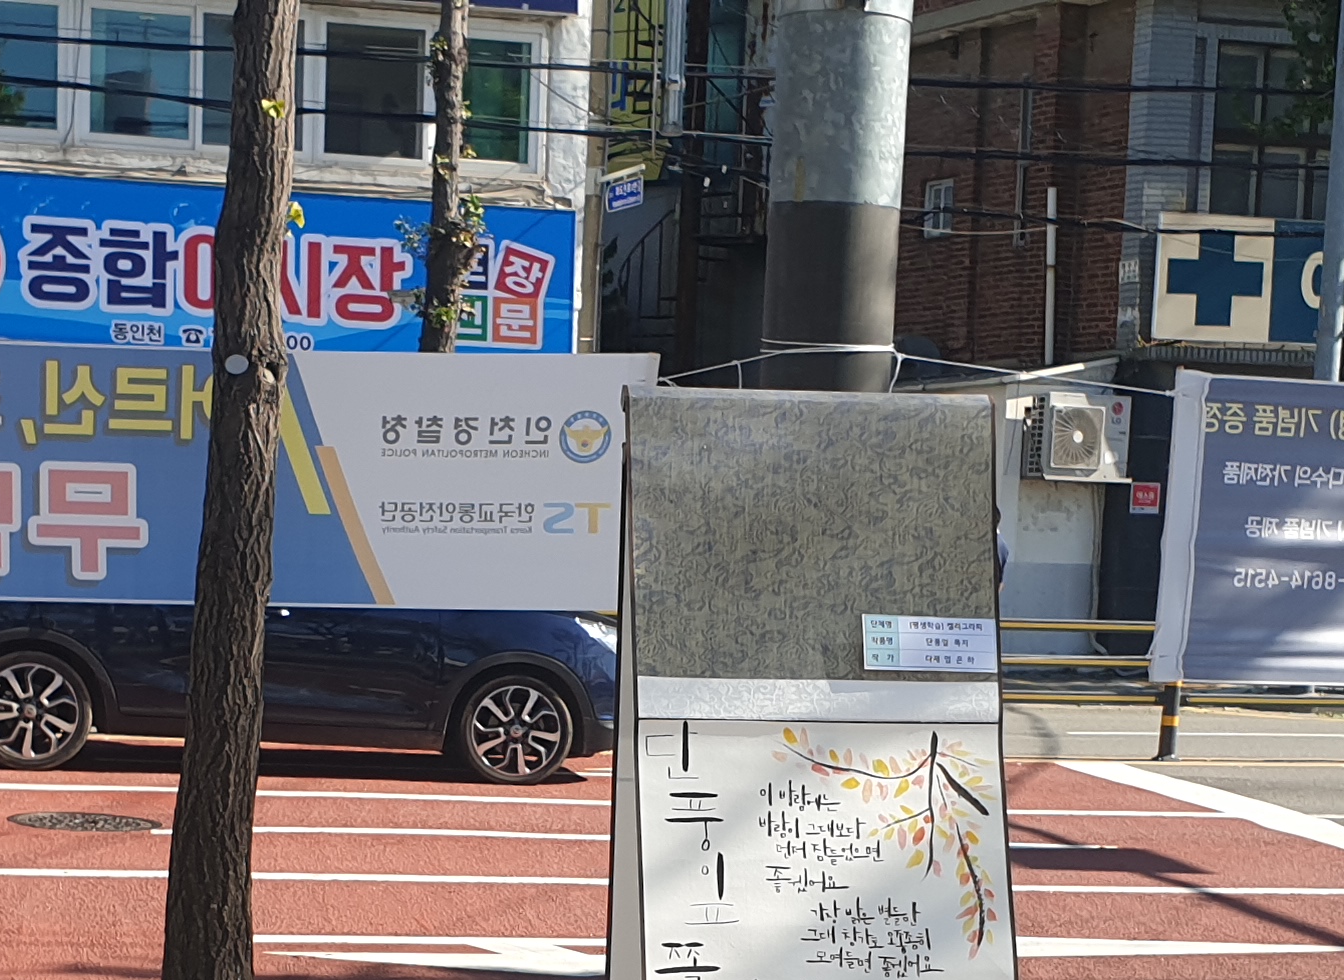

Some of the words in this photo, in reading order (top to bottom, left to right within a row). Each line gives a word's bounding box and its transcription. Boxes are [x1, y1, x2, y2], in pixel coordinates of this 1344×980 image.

[113, 322, 166, 344] 동인천
[870, 620, 893, 629] 단체명
[758, 810, 800, 839] 바람이
[805, 817, 867, 840] 그대보다
[765, 865, 850, 894] 좋겠어요
[810, 899, 841, 924] 가장
[845, 896, 876, 925] 밝은
[800, 925, 836, 944] 그대
[805, 946, 872, 973] 모여들면
